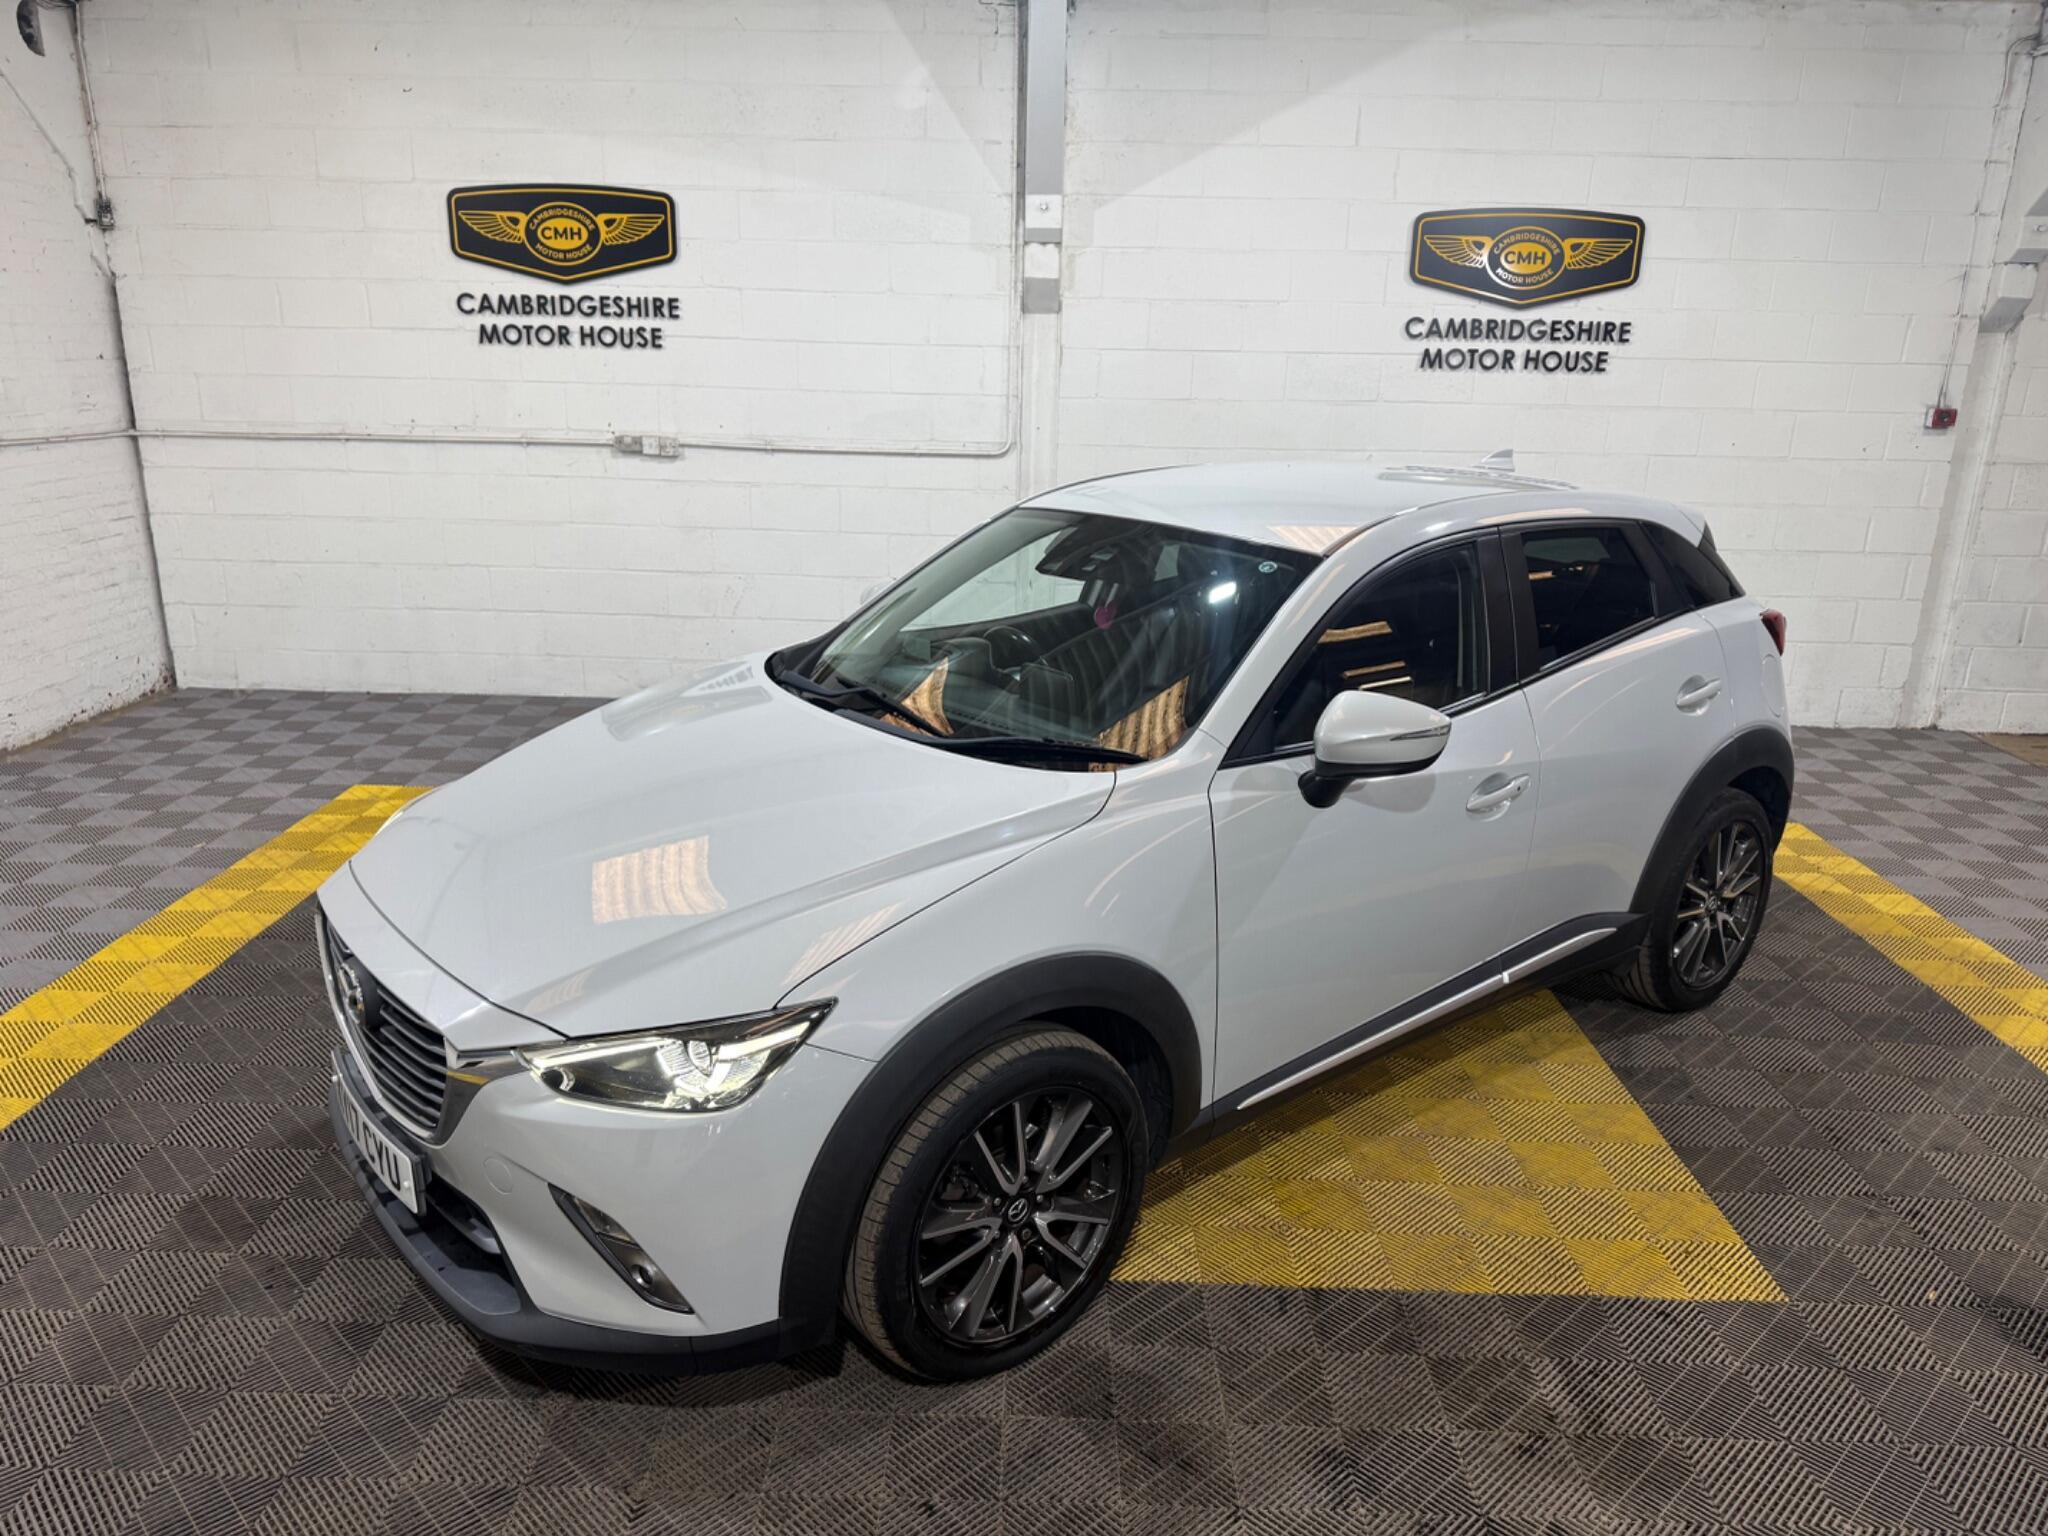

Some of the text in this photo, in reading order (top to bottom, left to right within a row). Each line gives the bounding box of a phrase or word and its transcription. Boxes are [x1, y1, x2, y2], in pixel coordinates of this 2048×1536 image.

[528, 207, 596, 232] CAMBRIDGESHIRE
[540, 226, 583, 241] CMH
[1493, 232, 1560, 256] CAMBRIDGESHIRE
[534, 243, 593, 260] MOTOR HOUSE
[1503, 250, 1547, 266] CMH
[1495, 267, 1554, 284] MOTOR HOUSE
[456, 292, 681, 320] CAMBRIDGESHIRE
[478, 323, 663, 349] MOTOR HOUSE
[1404, 316, 1632, 344] CAMBRIDGESHIRE
[1420, 347, 1609, 373] MOTOR HOUSE
[362, 1120, 401, 1192] CYU
